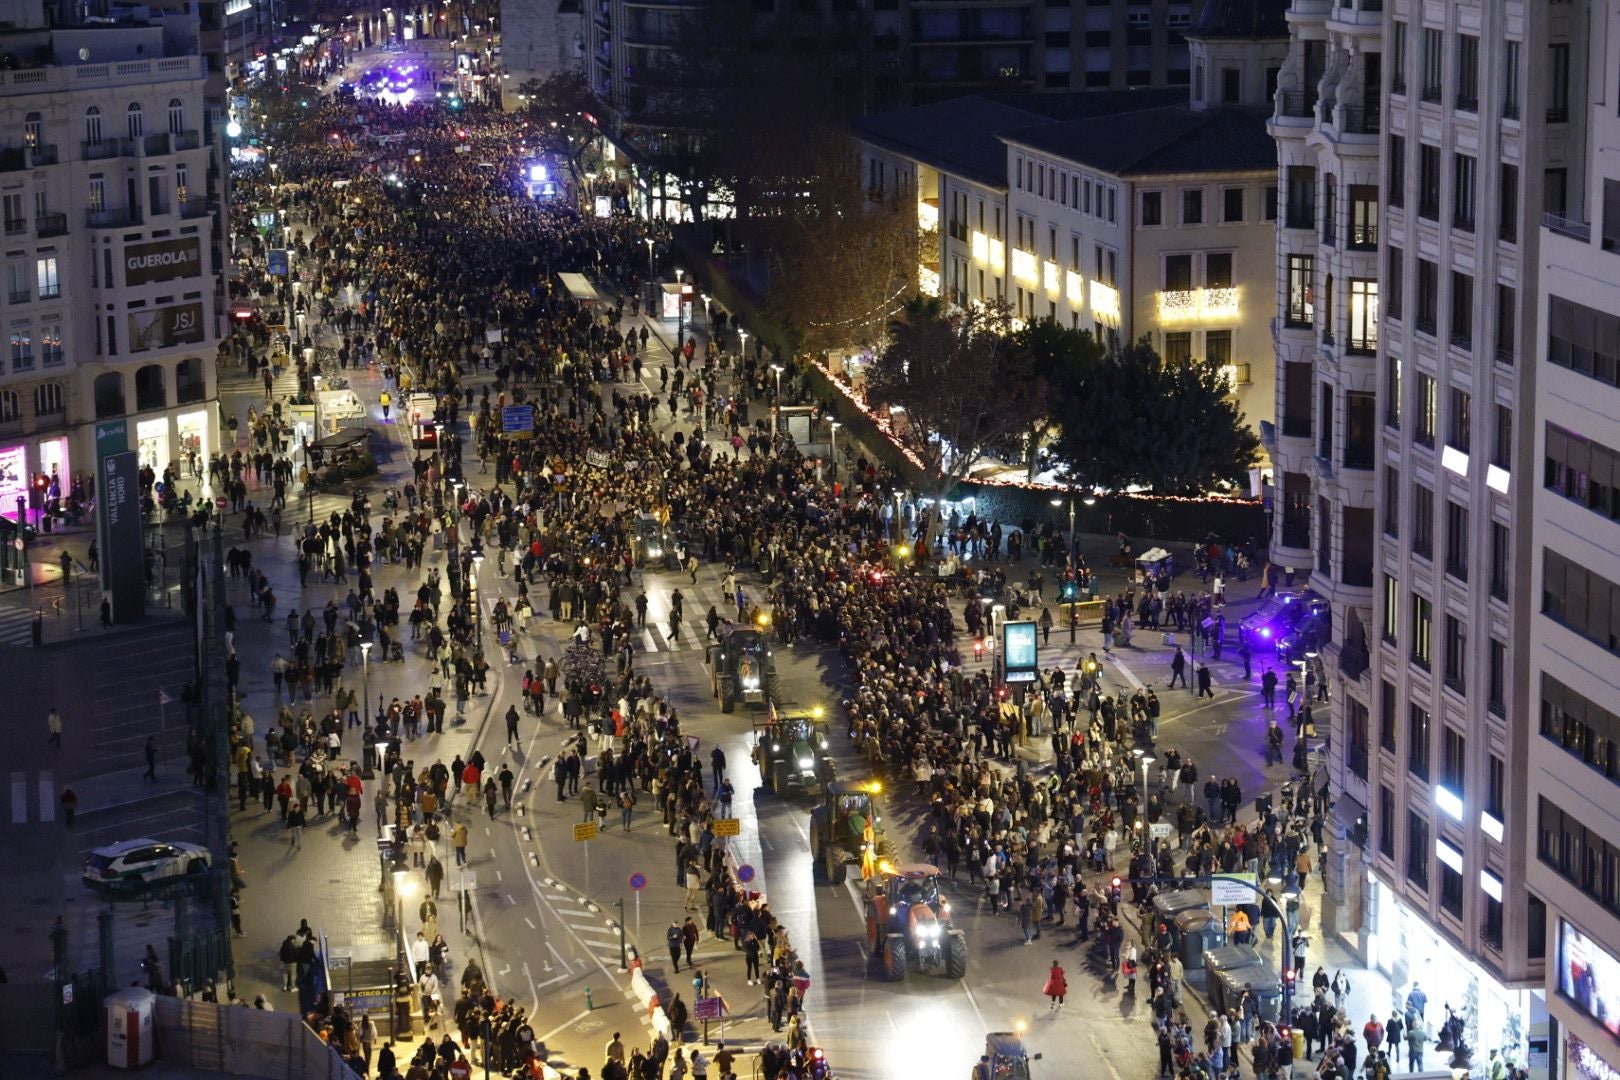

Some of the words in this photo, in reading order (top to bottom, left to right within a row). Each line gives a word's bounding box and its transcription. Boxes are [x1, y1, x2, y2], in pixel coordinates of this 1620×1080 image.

[128, 250, 188, 270] GUEROLA
[173, 311, 195, 330] JSJ
[117, 476, 126, 503] NORD
